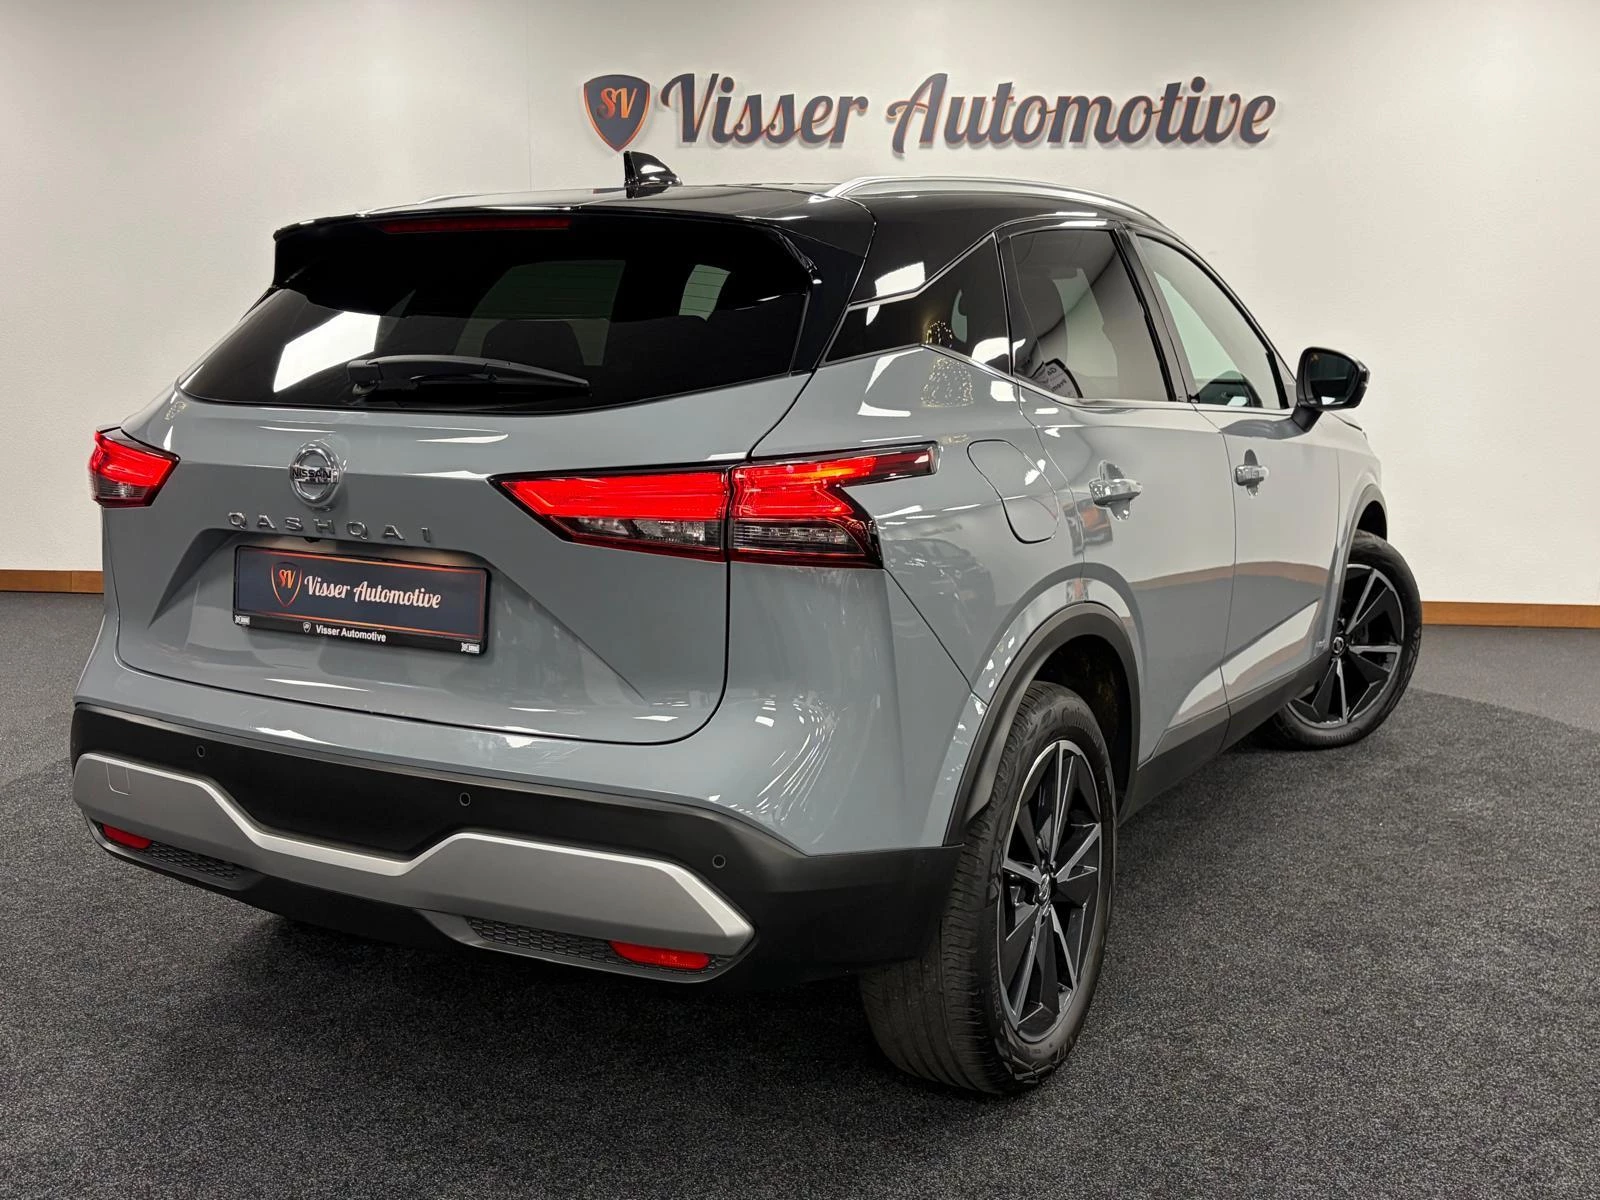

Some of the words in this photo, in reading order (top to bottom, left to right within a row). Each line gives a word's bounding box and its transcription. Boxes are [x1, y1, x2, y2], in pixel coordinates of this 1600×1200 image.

[660, 73, 869, 144] Visser
[886, 73, 1276, 154] Automotive
[292, 467, 332, 480] NISSAN
[227, 511, 432, 543] QASHQAI
[304, 575, 350, 599] Visser
[353, 581, 442, 609] Automotive
[315, 624, 340, 636] Visser
[340, 628, 387, 643] Automotive
